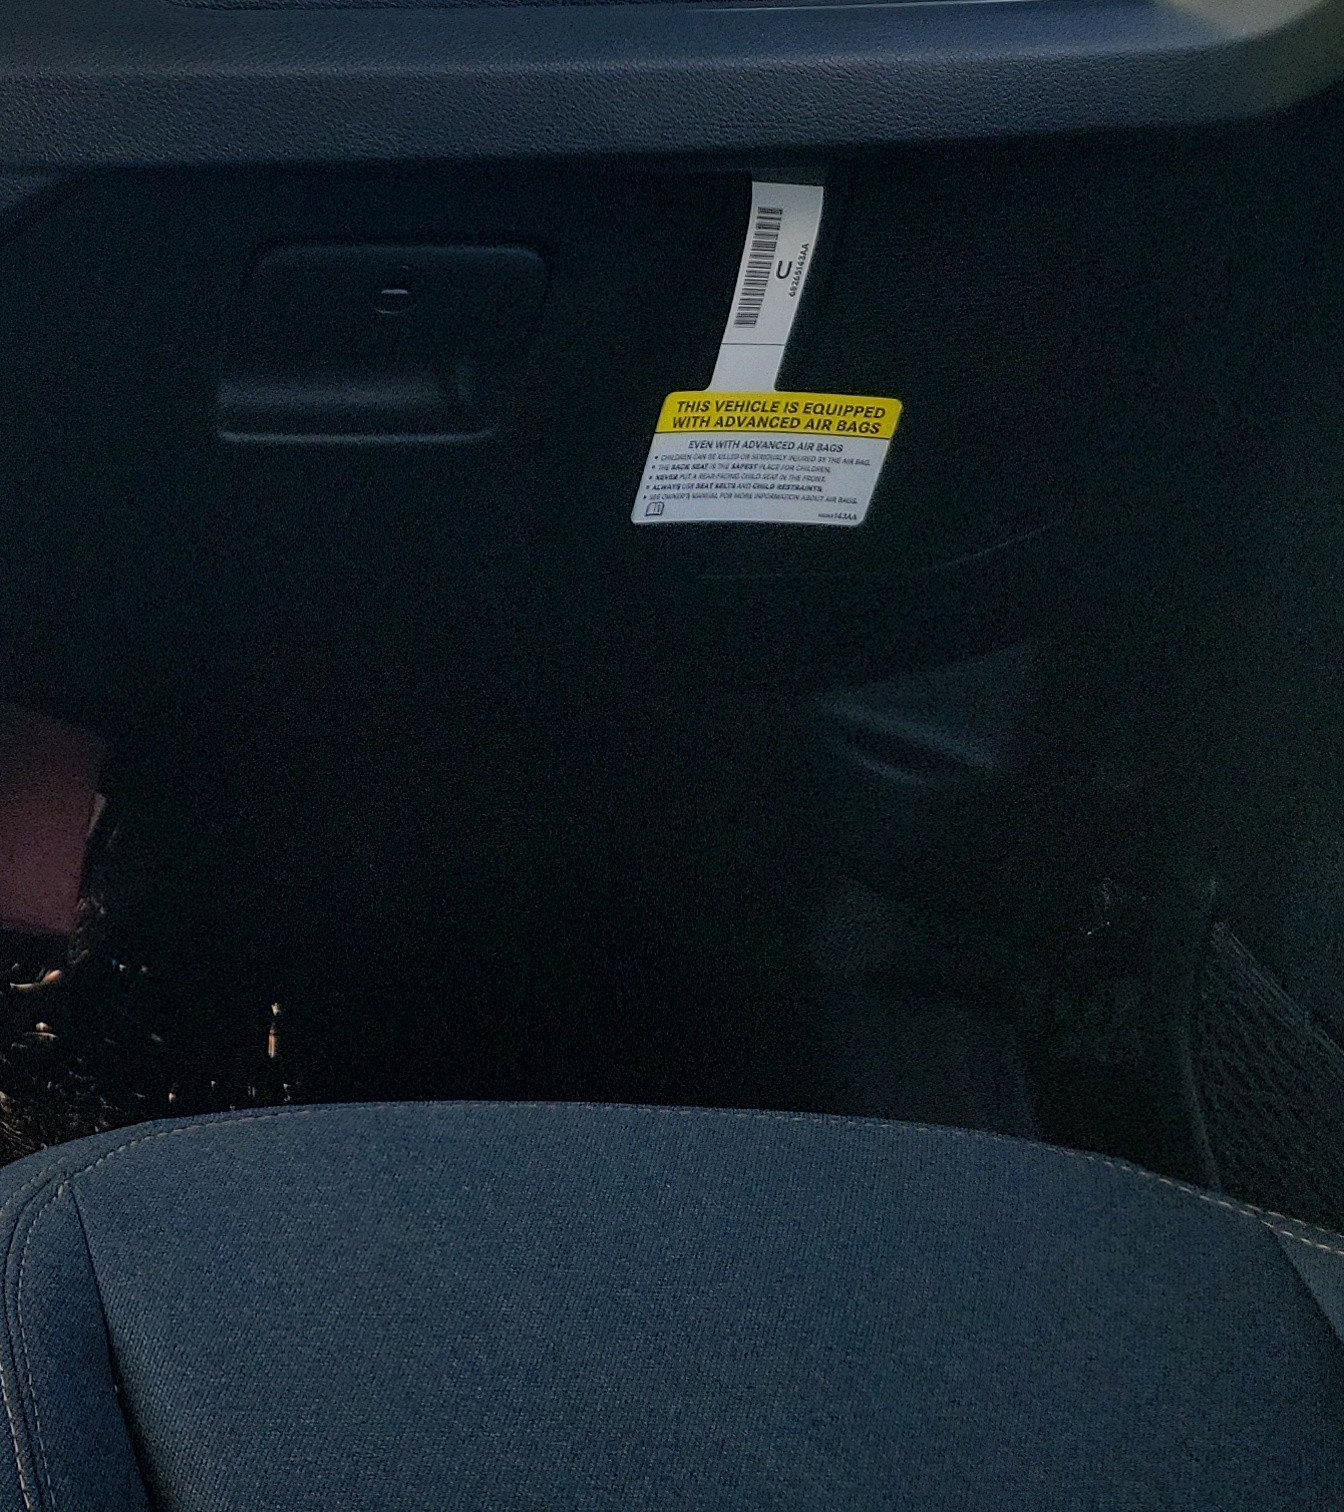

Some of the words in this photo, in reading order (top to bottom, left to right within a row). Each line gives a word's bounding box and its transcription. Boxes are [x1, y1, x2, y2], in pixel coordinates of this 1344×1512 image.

[775, 261, 793, 279] U
[676, 401, 711, 413] THIS
[714, 401, 781, 415] VEHICLE
[783, 402, 799, 414] IS
[804, 402, 886, 419] EQUIPPED
[672, 416, 710, 429] WITH
[713, 416, 801, 430] ADVANCED
[805, 418, 833, 432] AIR
[836, 420, 882, 435] BAGS
[688, 440, 713, 450] EVEN
[715, 440, 740, 450] WITH
[742, 440, 796, 451] ADVANCED
[797, 441, 815, 452] AIR
[816, 443, 843, 453] BAGS
